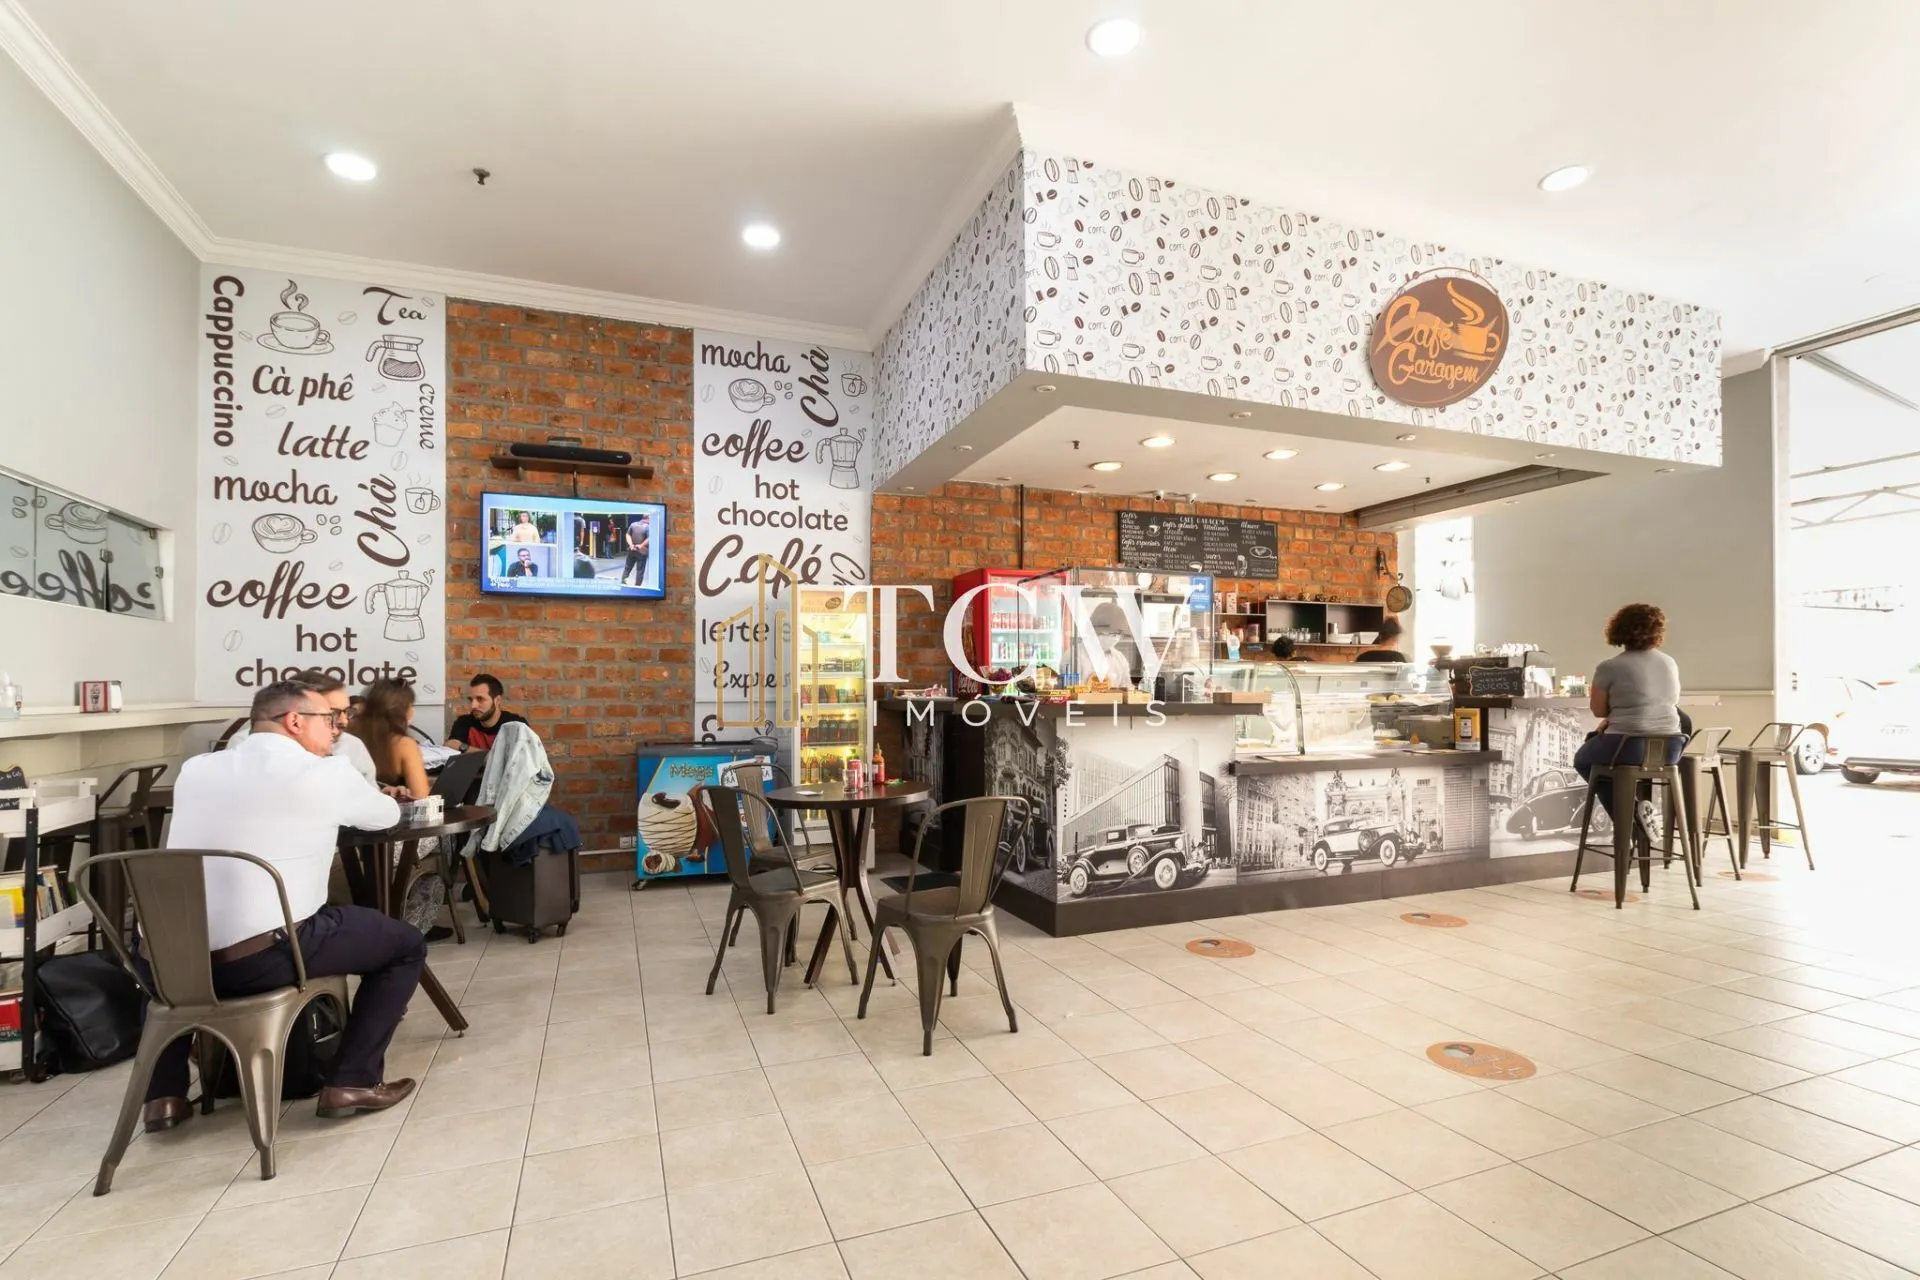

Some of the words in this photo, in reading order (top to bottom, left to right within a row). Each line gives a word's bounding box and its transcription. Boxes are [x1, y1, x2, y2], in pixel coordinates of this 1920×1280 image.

[362, 286, 426, 326] Tea
[206, 275, 244, 447] Cappuccino
[702, 340, 790, 374] mocha
[1388, 342, 1479, 389] Garagem
[252, 364, 295, 396] Cà
[298, 372, 354, 406] phê
[798, 346, 839, 428] Chá
[277, 421, 370, 460] latte
[702, 418, 810, 468] coffee
[214, 469, 338, 506] mocha
[755, 474, 800, 500] hot
[354, 474, 410, 568] Chá
[718, 501, 848, 532] chocolate
[700, 534, 823, 599] Café
[206, 560, 359, 620] coffee
[296, 624, 358, 652] hot
